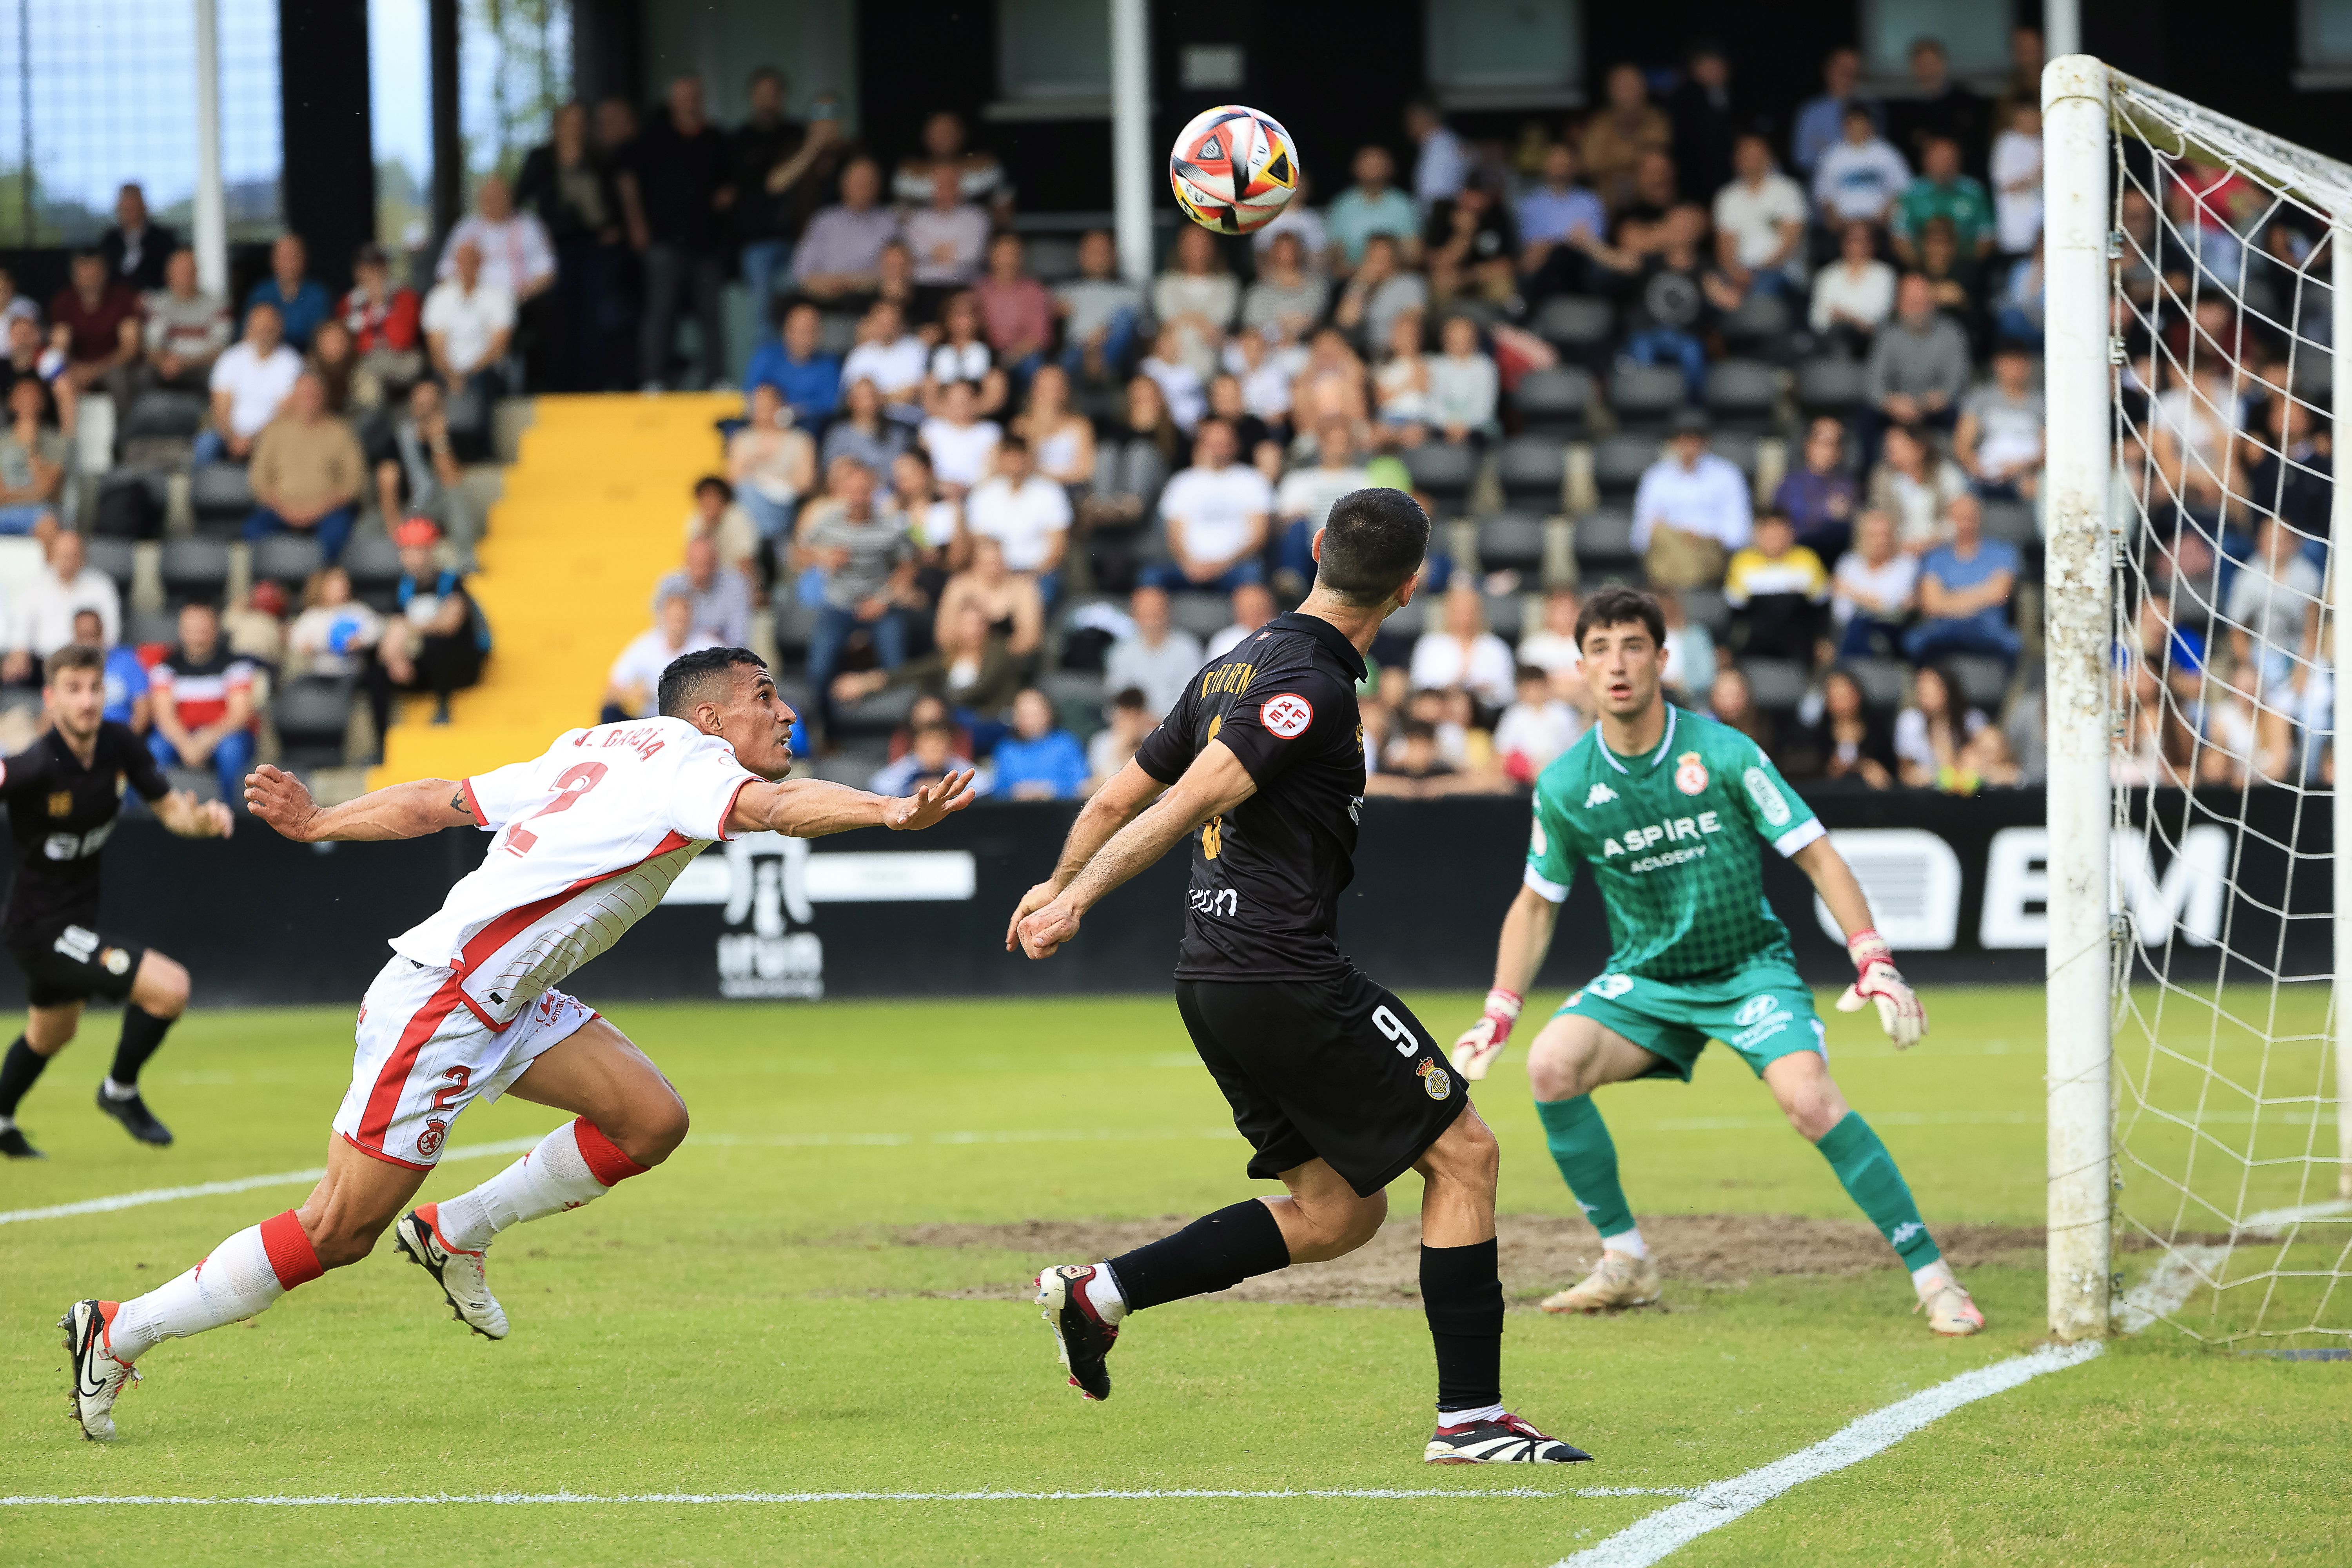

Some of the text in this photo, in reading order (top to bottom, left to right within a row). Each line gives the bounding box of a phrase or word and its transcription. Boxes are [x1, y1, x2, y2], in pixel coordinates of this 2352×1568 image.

[498, 761, 608, 858] 2
[1603, 810, 1722, 858] ASPIRE
[1630, 844, 1707, 874] ACADEMY
[53, 924, 100, 964] 10
[1372, 1005, 1419, 1058] 9
[428, 1065, 472, 1111] 2
